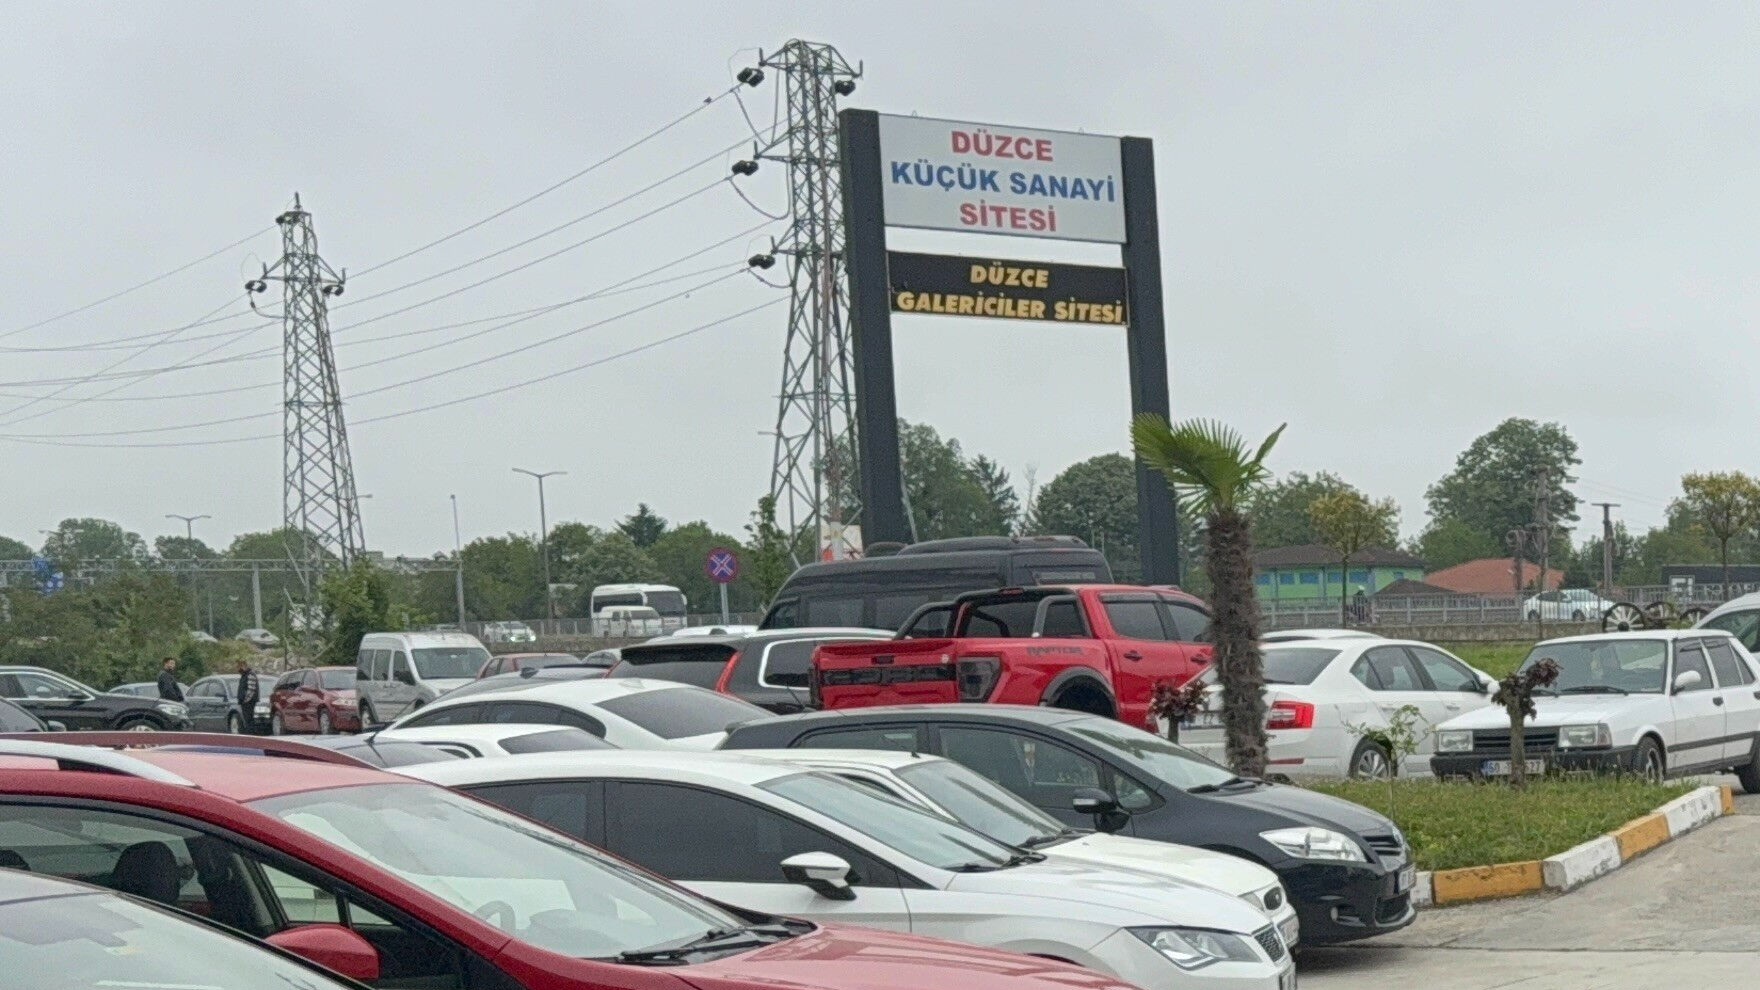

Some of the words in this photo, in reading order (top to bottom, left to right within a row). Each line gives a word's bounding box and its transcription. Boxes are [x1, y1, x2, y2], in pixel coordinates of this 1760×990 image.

[951, 128, 1053, 162] DÜZCE
[890, 159, 1000, 192] KÜÇÜK
[1010, 172, 1115, 202] SANAYİ
[959, 199, 1057, 232] SİTESİ
[970, 261, 1049, 289] DÜZCE
[897, 291, 1045, 319] GALERİCİLER
[1054, 297, 1123, 324] SİTESİ
